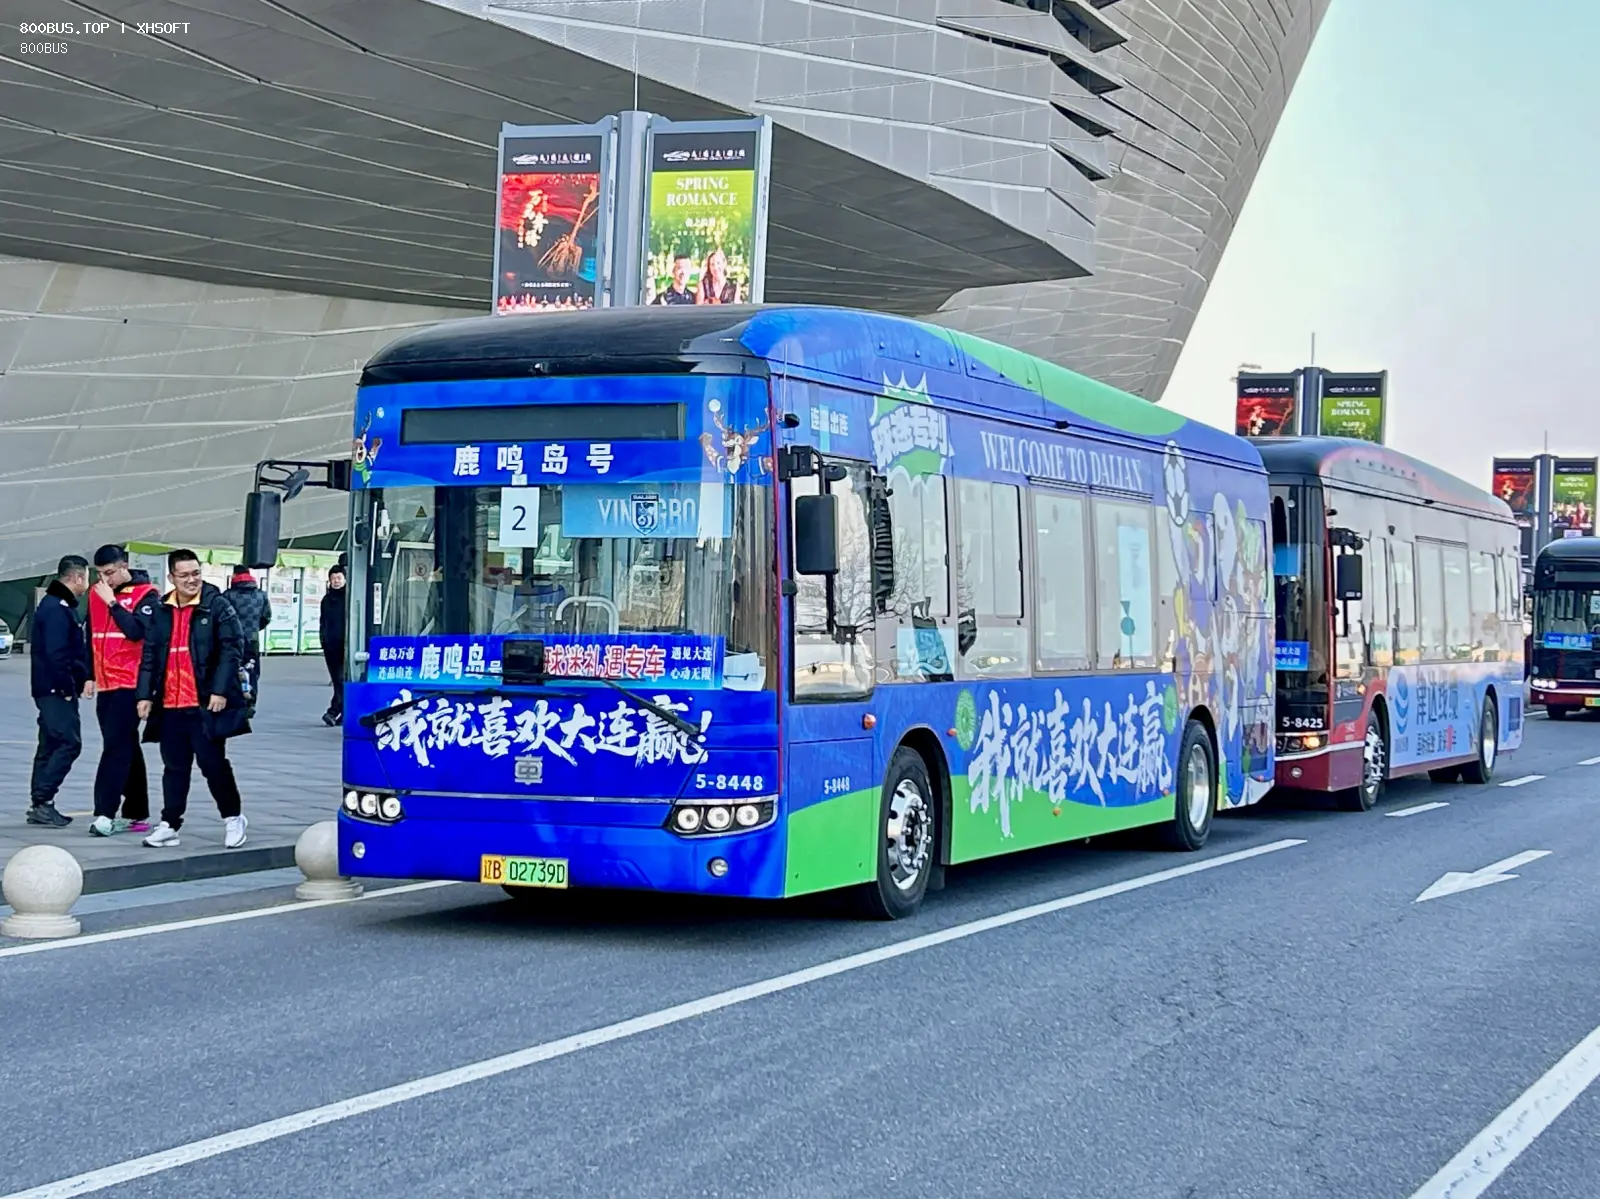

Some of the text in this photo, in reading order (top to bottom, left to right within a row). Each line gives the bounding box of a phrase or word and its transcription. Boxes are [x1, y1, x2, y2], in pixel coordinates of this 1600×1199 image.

[676, 176, 729, 191] SPRING
[666, 192, 738, 207] ROMANCE
[453, 443, 614, 477] 鹿鸣岛号
[980, 431, 1143, 491] WELCOME TO DALIAN
[511, 505, 527, 531] 2
[1282, 716, 1324, 729] 5-8425
[695, 773, 763, 791] 5-8448
[509, 861, 566, 884] 02739D
